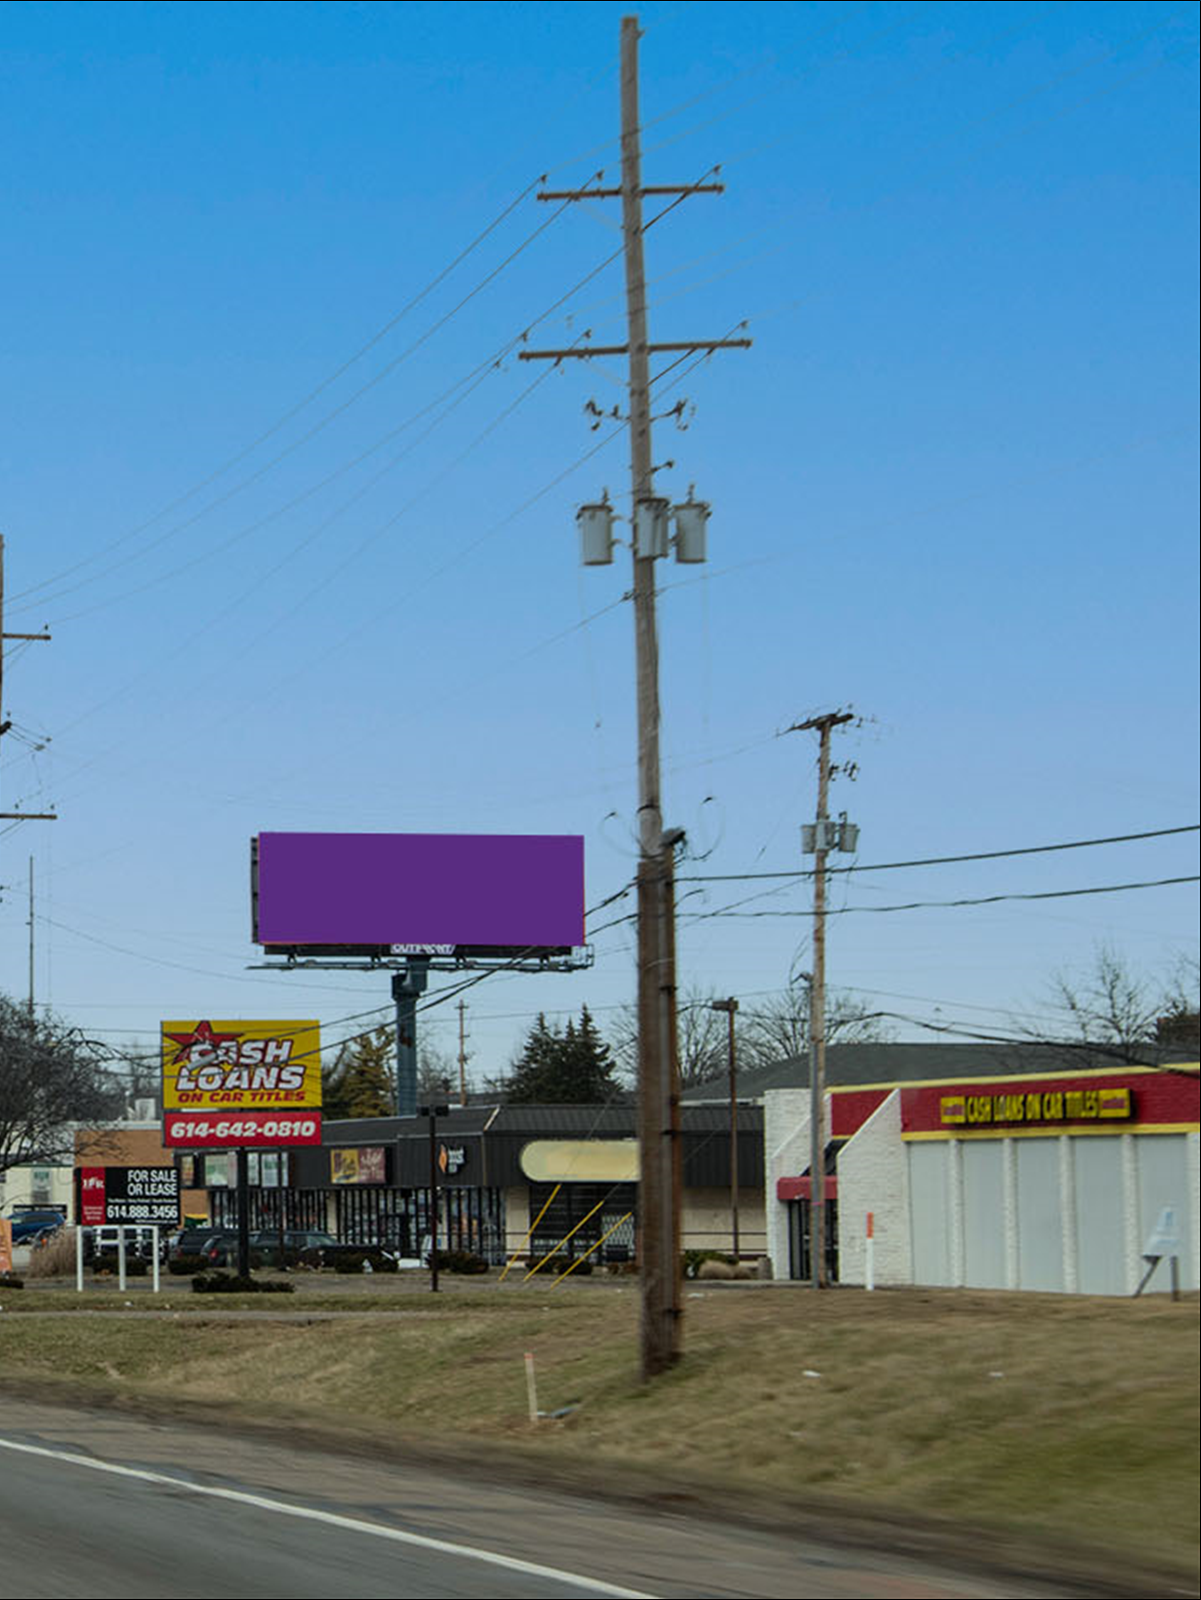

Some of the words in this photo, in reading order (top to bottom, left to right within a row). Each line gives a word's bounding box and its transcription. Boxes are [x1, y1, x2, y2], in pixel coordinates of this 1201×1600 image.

[189, 1040, 292, 1065] CASH
[177, 1066, 306, 1090] LOANS
[178, 1093, 203, 1103] ON
[209, 1092, 244, 1103] CAR
[250, 1091, 307, 1102] TITLES
[967, 1095, 992, 1123] CASH
[1026, 1093, 1041, 1120] ON
[1043, 1092, 1063, 1119] CAR
[171, 1121, 316, 1138] 614-642-0810
[127, 1169, 149, 1182] FOR
[150, 1169, 178, 1182] SALE
[127, 1183, 143, 1196] OR
[145, 1183, 178, 1196] LEASE
[106, 1205, 178, 1218] 614.888.3456
